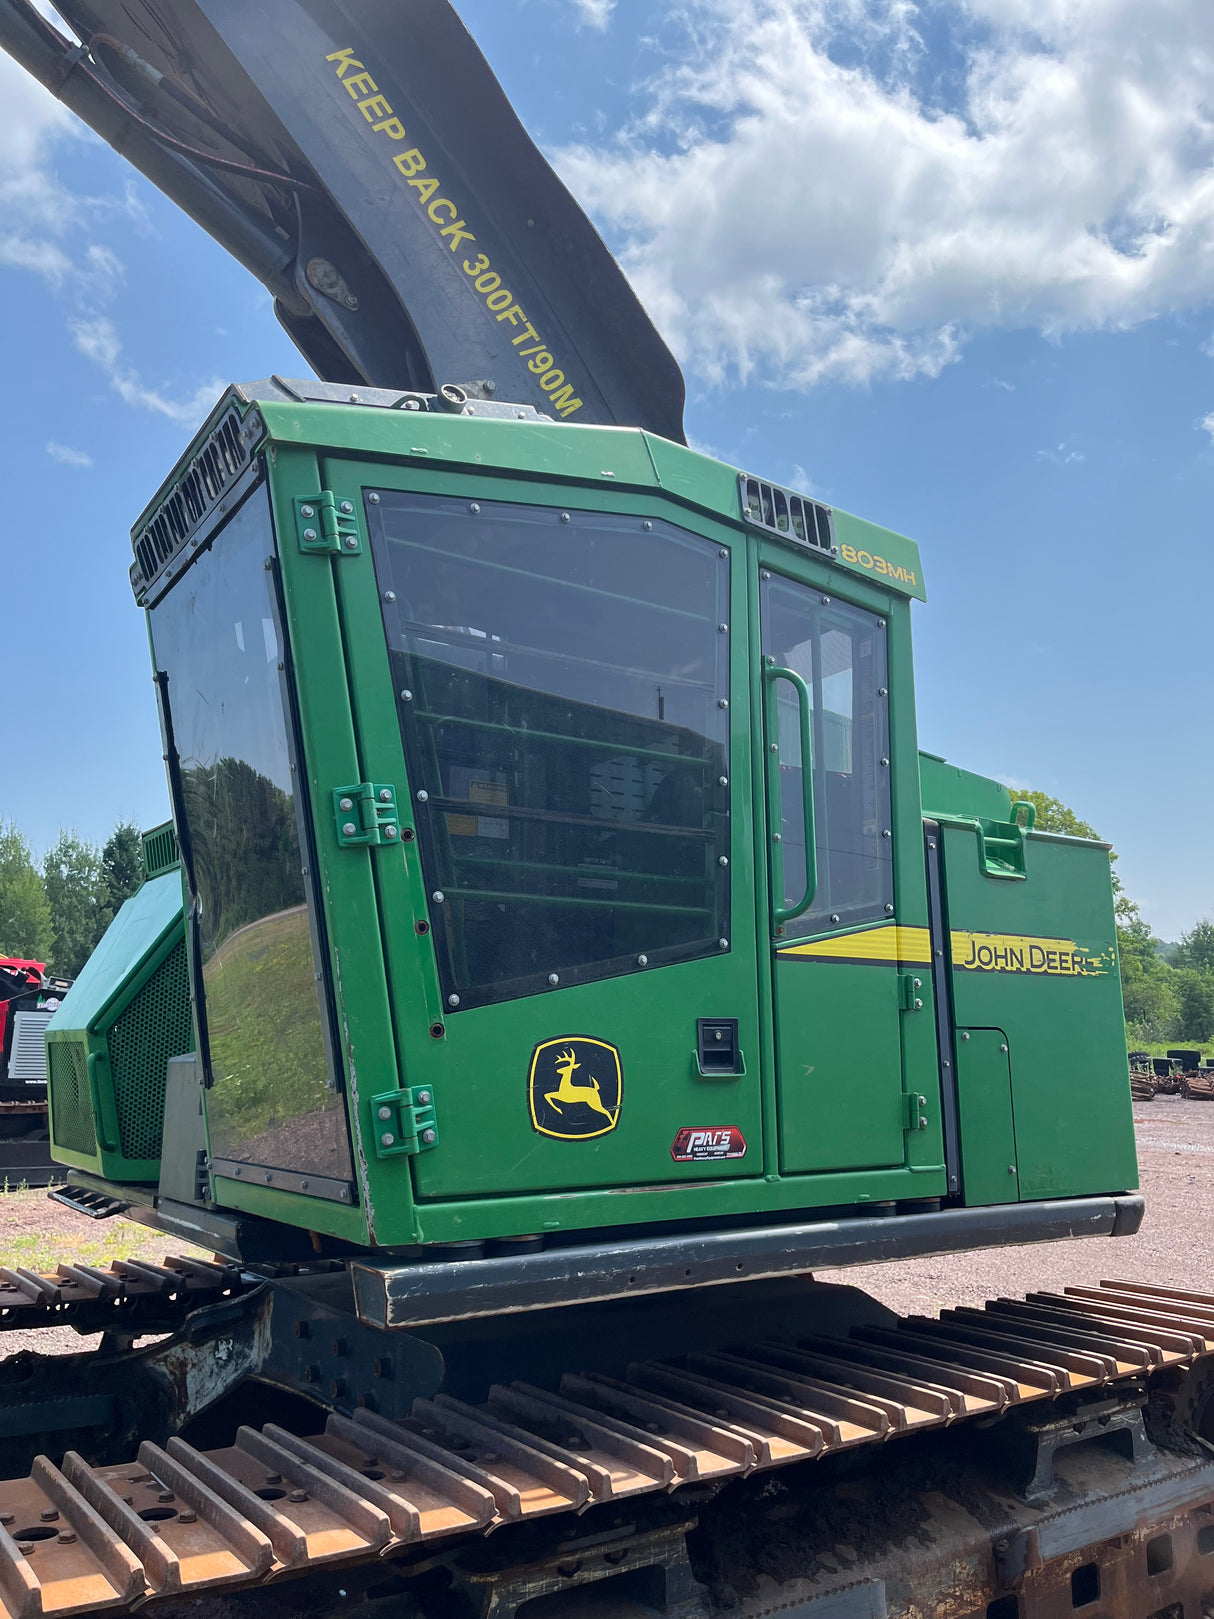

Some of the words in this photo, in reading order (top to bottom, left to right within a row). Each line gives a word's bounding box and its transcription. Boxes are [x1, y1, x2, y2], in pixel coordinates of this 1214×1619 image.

[325, 47, 406, 141] KEEP
[392, 148, 476, 252] BACK
[462, 253, 584, 418] 300FT/90M
[840, 543, 916, 586] 803MH
[964, 940, 1025, 968] JOHN
